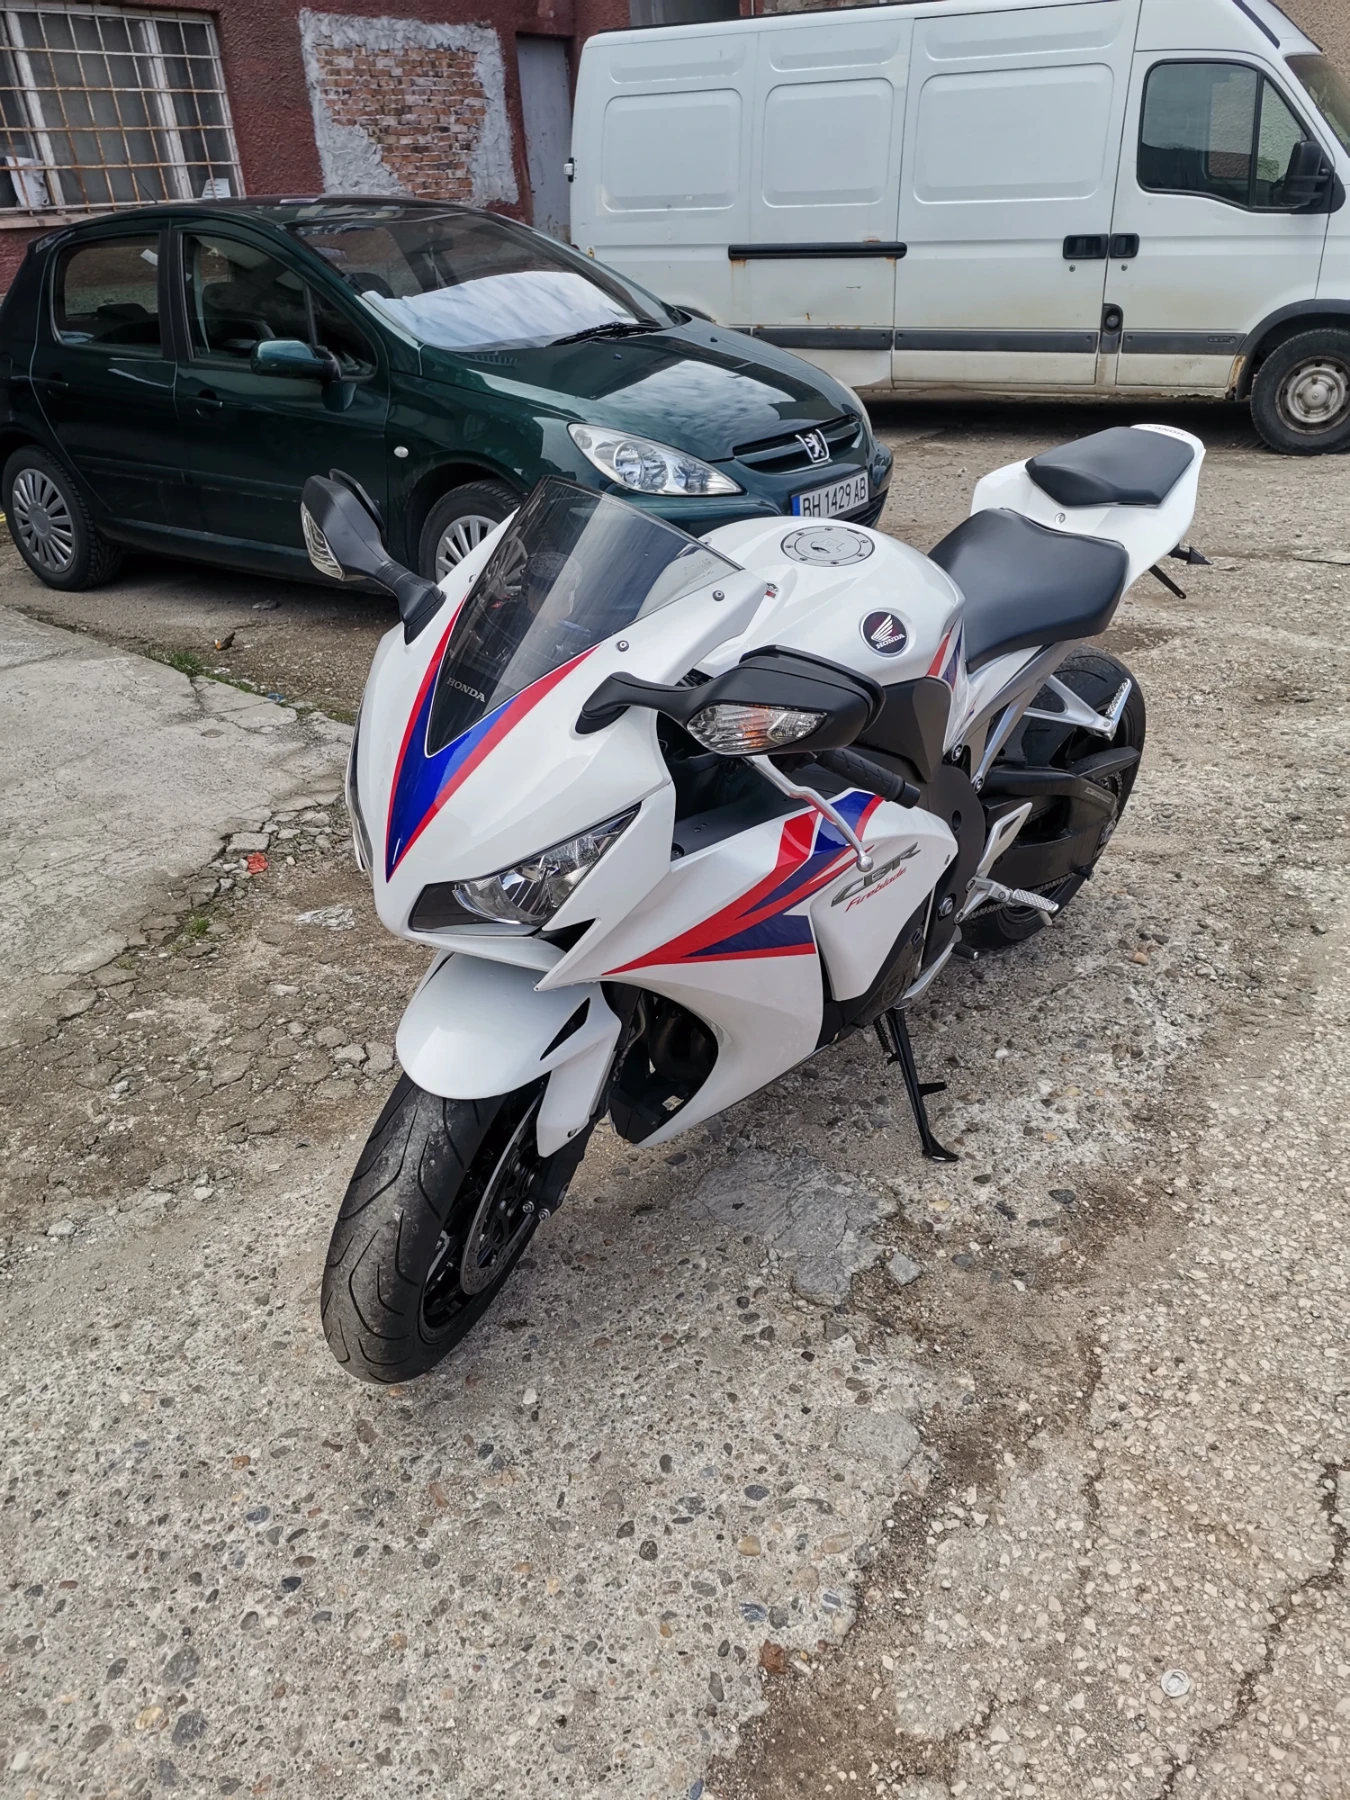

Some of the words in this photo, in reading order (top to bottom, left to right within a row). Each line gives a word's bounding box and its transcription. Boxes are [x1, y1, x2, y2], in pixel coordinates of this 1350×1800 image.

[803, 493, 821, 517] BH
[825, 483, 852, 514] 1429
[854, 477, 867, 504] AB
[876, 633, 906, 650] HONDA
[446, 677, 486, 703] HONDA
[830, 841, 921, 908] CBR
[844, 866, 908, 913] Fireblade
